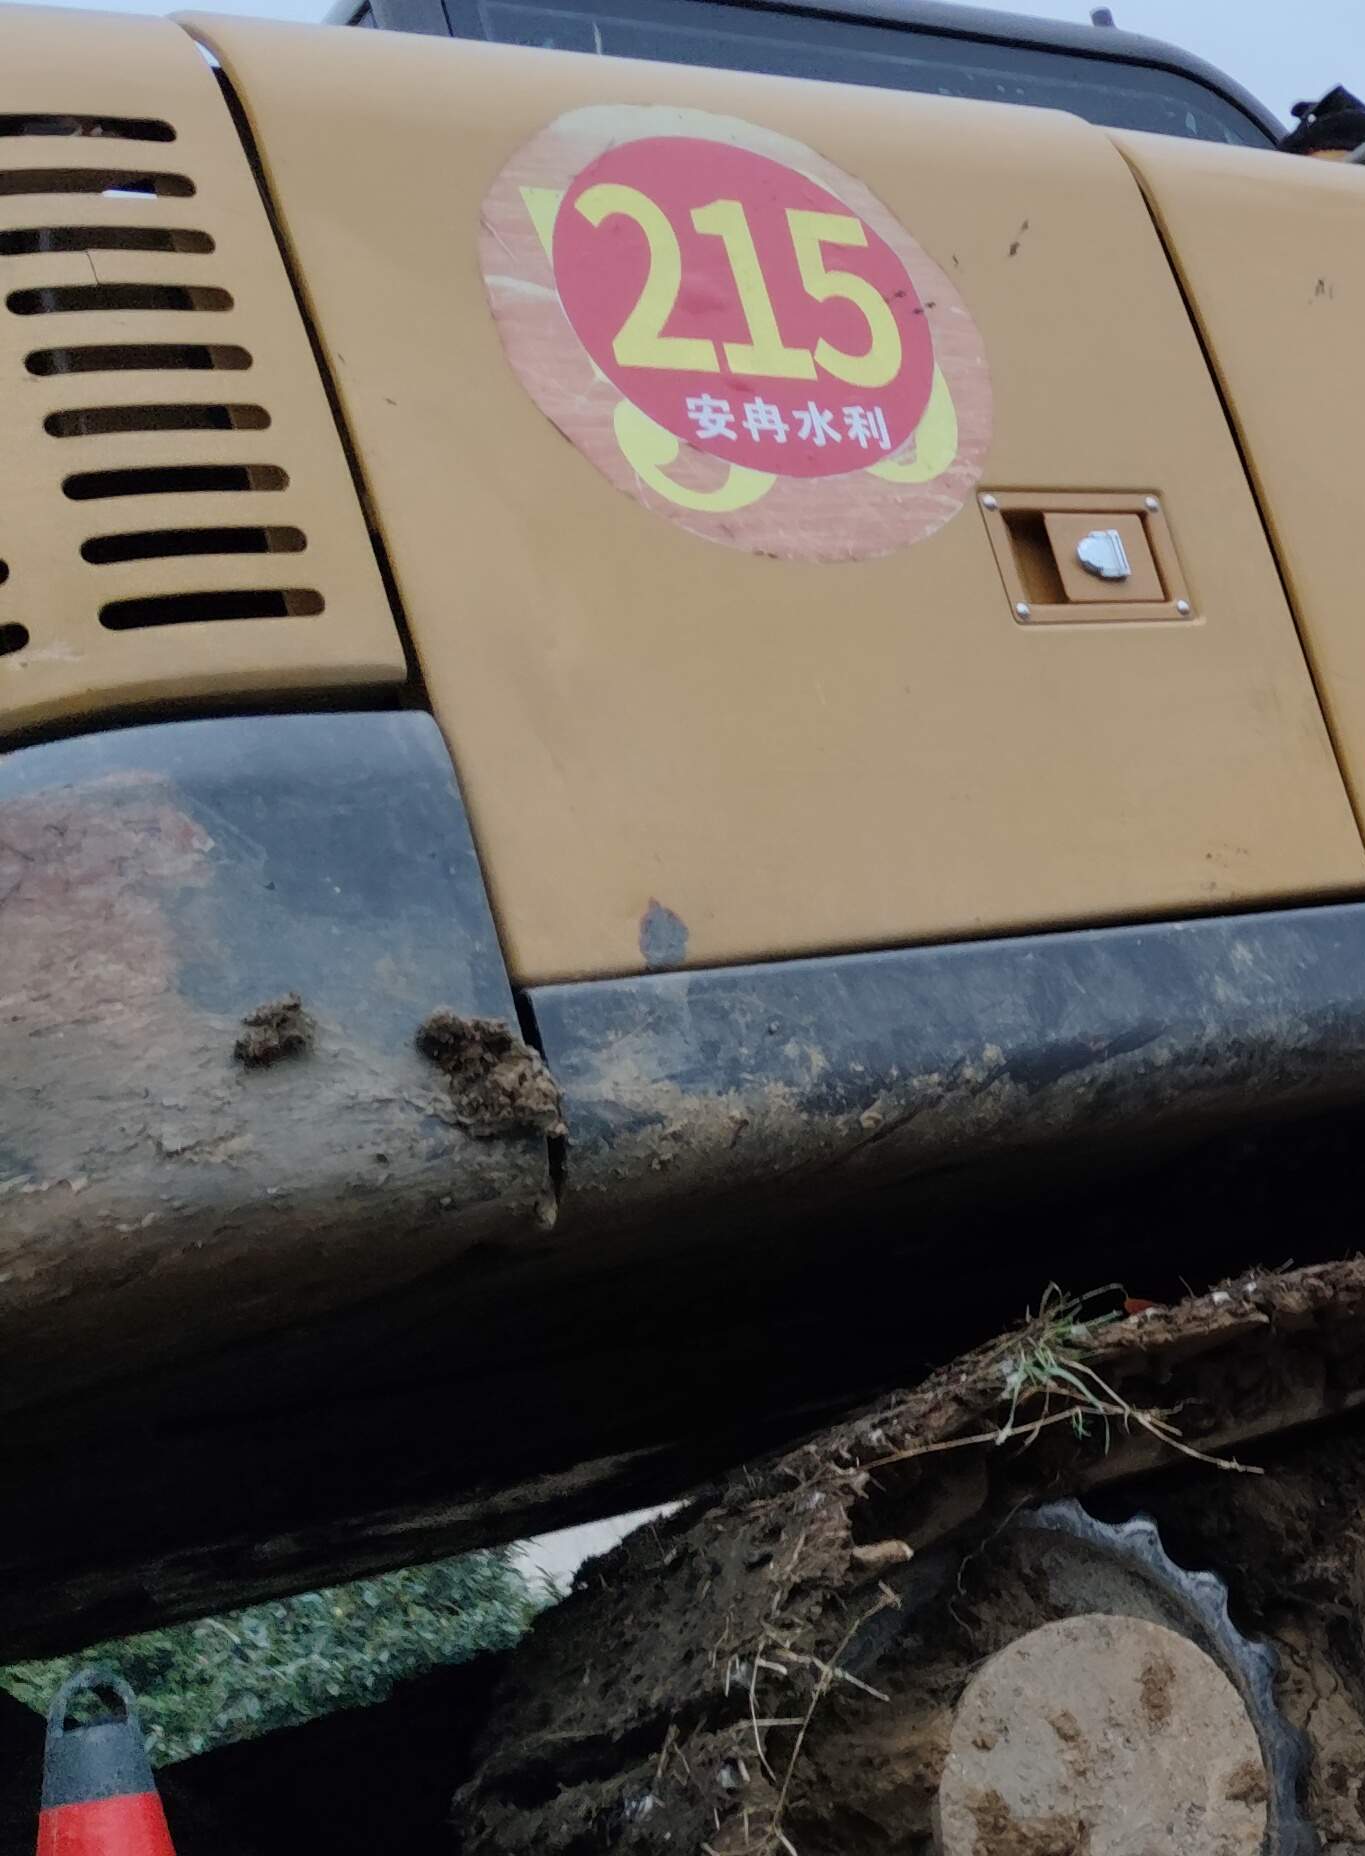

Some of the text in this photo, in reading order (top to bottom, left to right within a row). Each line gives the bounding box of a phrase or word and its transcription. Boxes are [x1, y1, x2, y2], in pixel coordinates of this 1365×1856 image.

[573, 183, 902, 388] 215
[686, 394, 892, 450] 安冉水利
